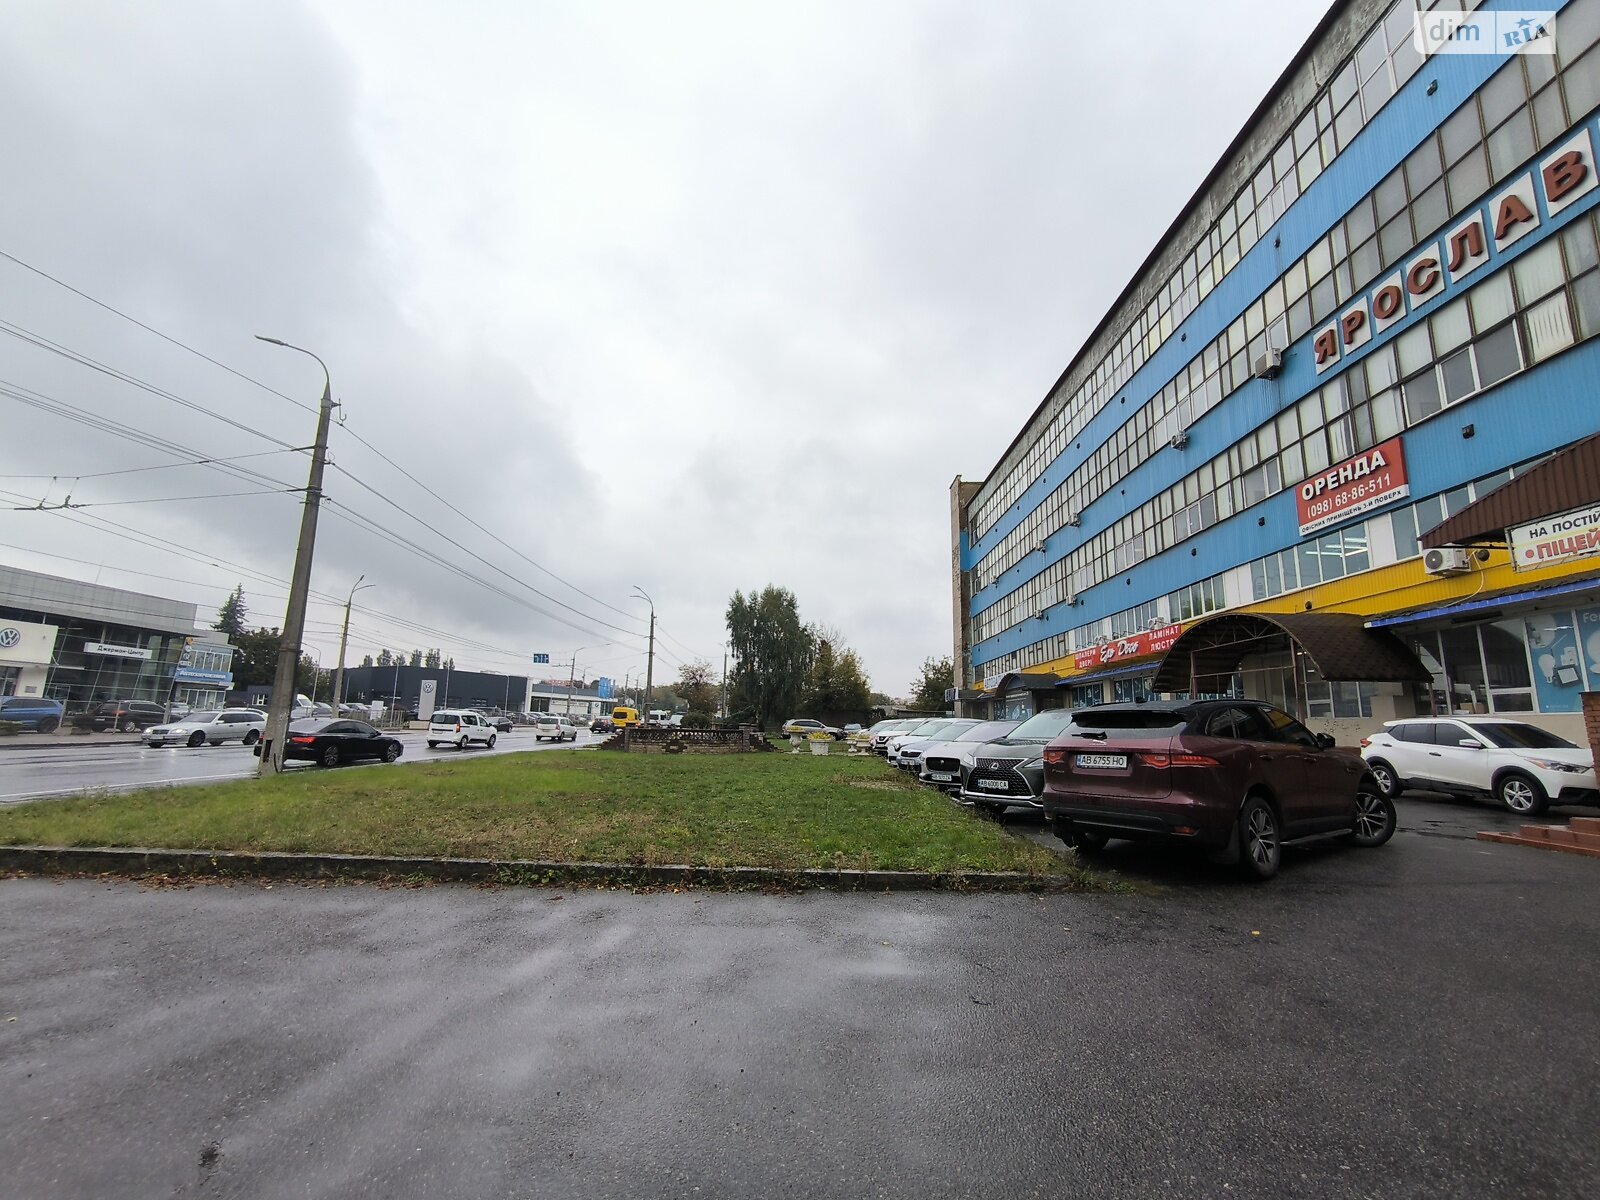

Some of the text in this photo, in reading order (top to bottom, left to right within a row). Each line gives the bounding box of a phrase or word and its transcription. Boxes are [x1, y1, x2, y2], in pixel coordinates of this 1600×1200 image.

[1313, 150, 1588, 364] ЯРОСЛАВ
[1301, 450, 1387, 501] ОРЕНДА
[1307, 472, 1391, 519] (098) 68-86-511
[1301, 519, 1326, 533] ОФІСНИХ
[1326, 506, 1362, 524] ПРИМІЩЕНЬ
[1374, 489, 1403, 505] ПОВЕРХ
[1529, 526, 1548, 539] НА
[1583, 611, 1600, 623] Fe
[1149, 625, 1179, 641] ЛАМІНАТ
[1150, 637, 1177, 652] ЛЮСТР
[1081, 755, 1092, 765] AB
[1093, 756, 1111, 765] 6755
